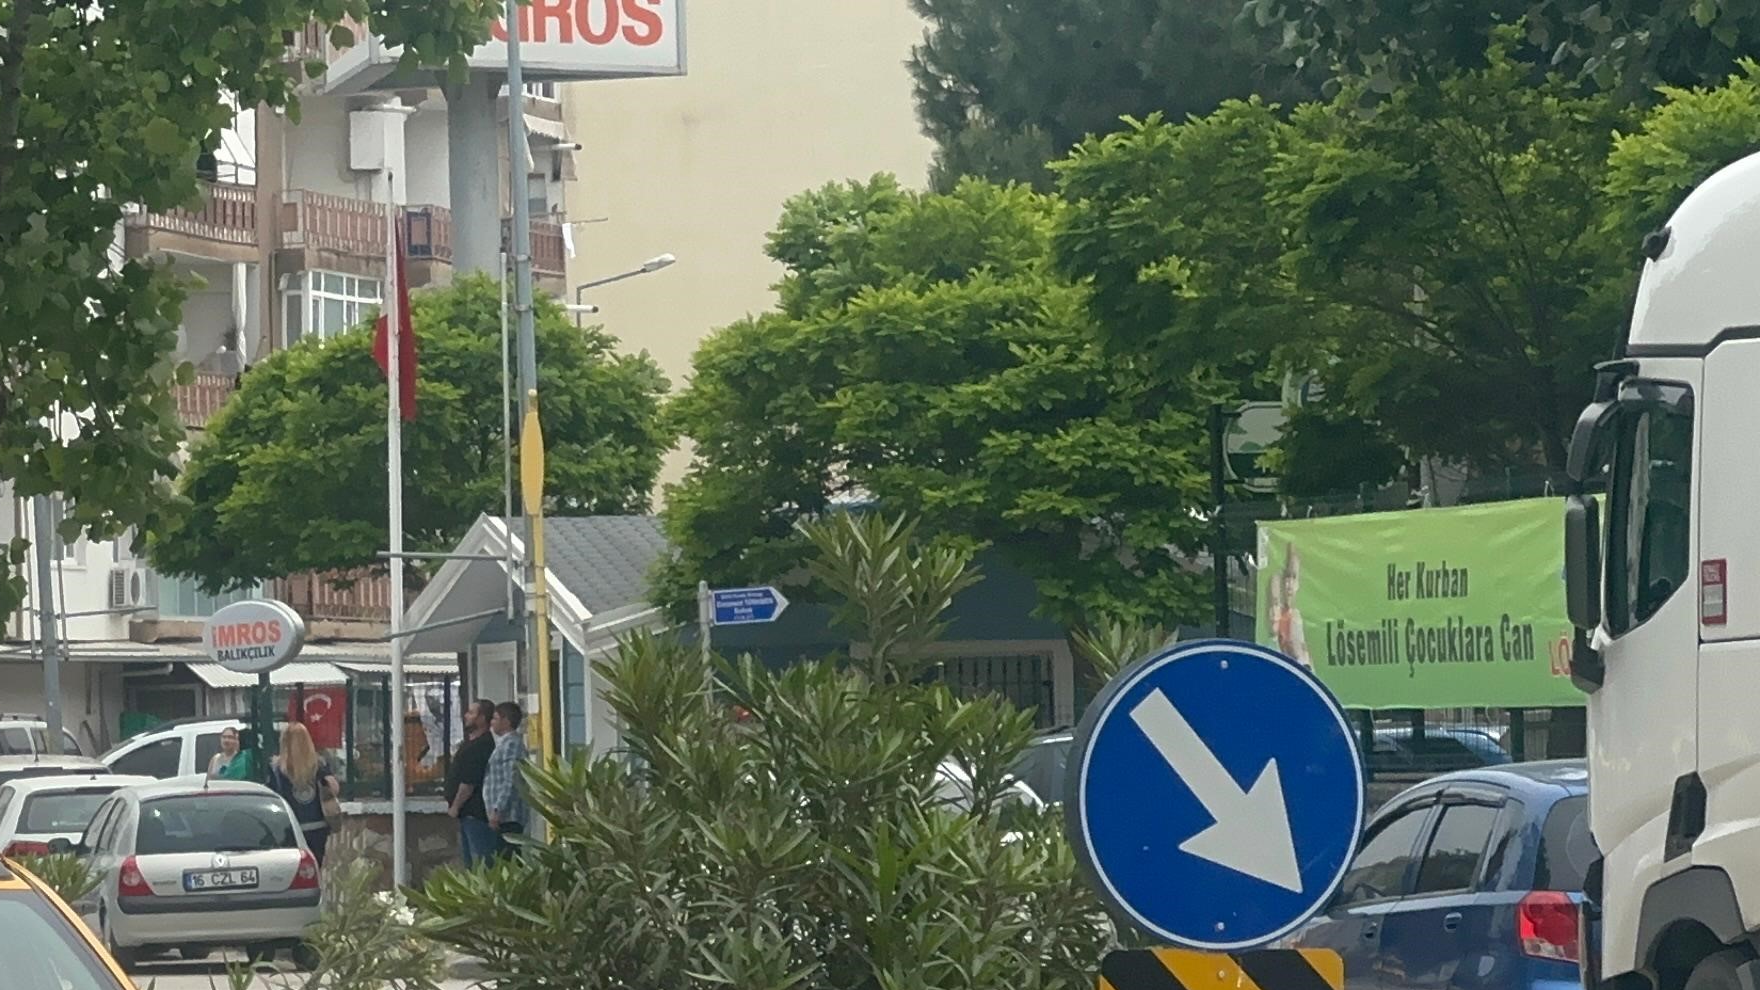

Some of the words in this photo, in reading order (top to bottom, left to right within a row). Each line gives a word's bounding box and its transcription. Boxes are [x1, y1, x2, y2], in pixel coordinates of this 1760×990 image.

[1387, 563, 1411, 600] Her
[1416, 560, 1469, 600] Kurban
[217, 645, 276, 663] BALIKÇILIK
[1327, 618, 1400, 667] Lösemili
[1405, 616, 1495, 678] Çocuklara
[1500, 613, 1535, 661] Can
[193, 874, 205, 886] 16
[211, 873, 236, 885] CZL
[240, 870, 255, 883] 64
